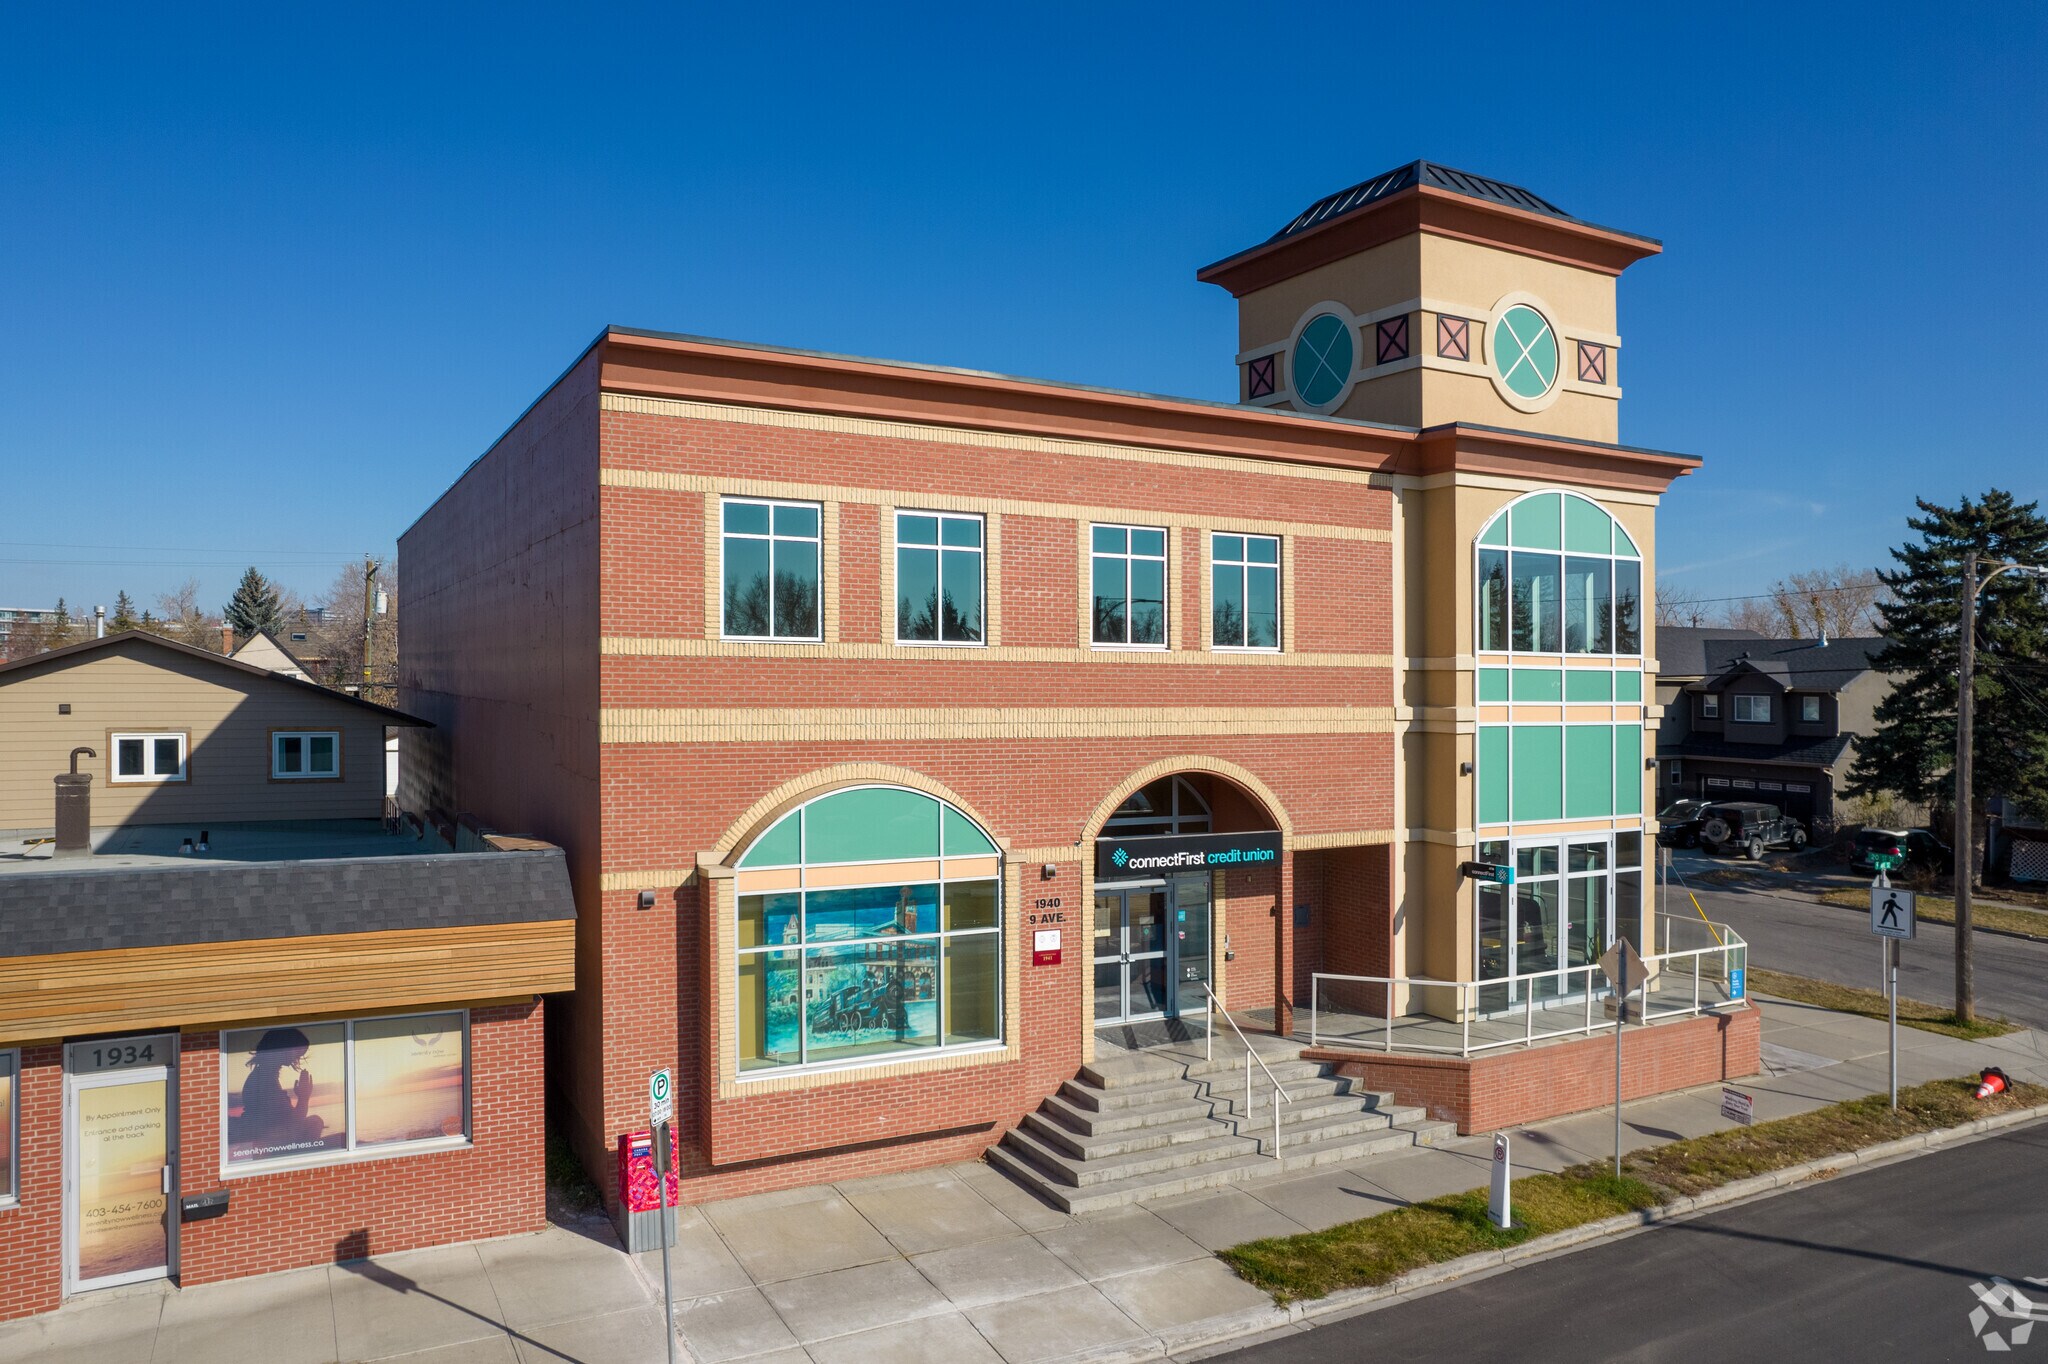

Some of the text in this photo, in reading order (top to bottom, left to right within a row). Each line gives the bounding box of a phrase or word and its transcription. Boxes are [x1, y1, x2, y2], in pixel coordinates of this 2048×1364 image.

[1129, 848, 1274, 868] connectFirst credit union
[1035, 898, 1061, 909] 1940
[1030, 913, 1066, 925] 9 AVE.
[93, 1044, 154, 1067] 1934
[96, 1109, 143, 1121] Appointment
[84, 1122, 161, 1137] Entrance and parking
[112, 1133, 125, 1141] the
[126, 1131, 145, 1139] back
[232, 1140, 325, 1158] serenitynowwellness.ca
[86, 1199, 163, 1218] 403-454-7600
